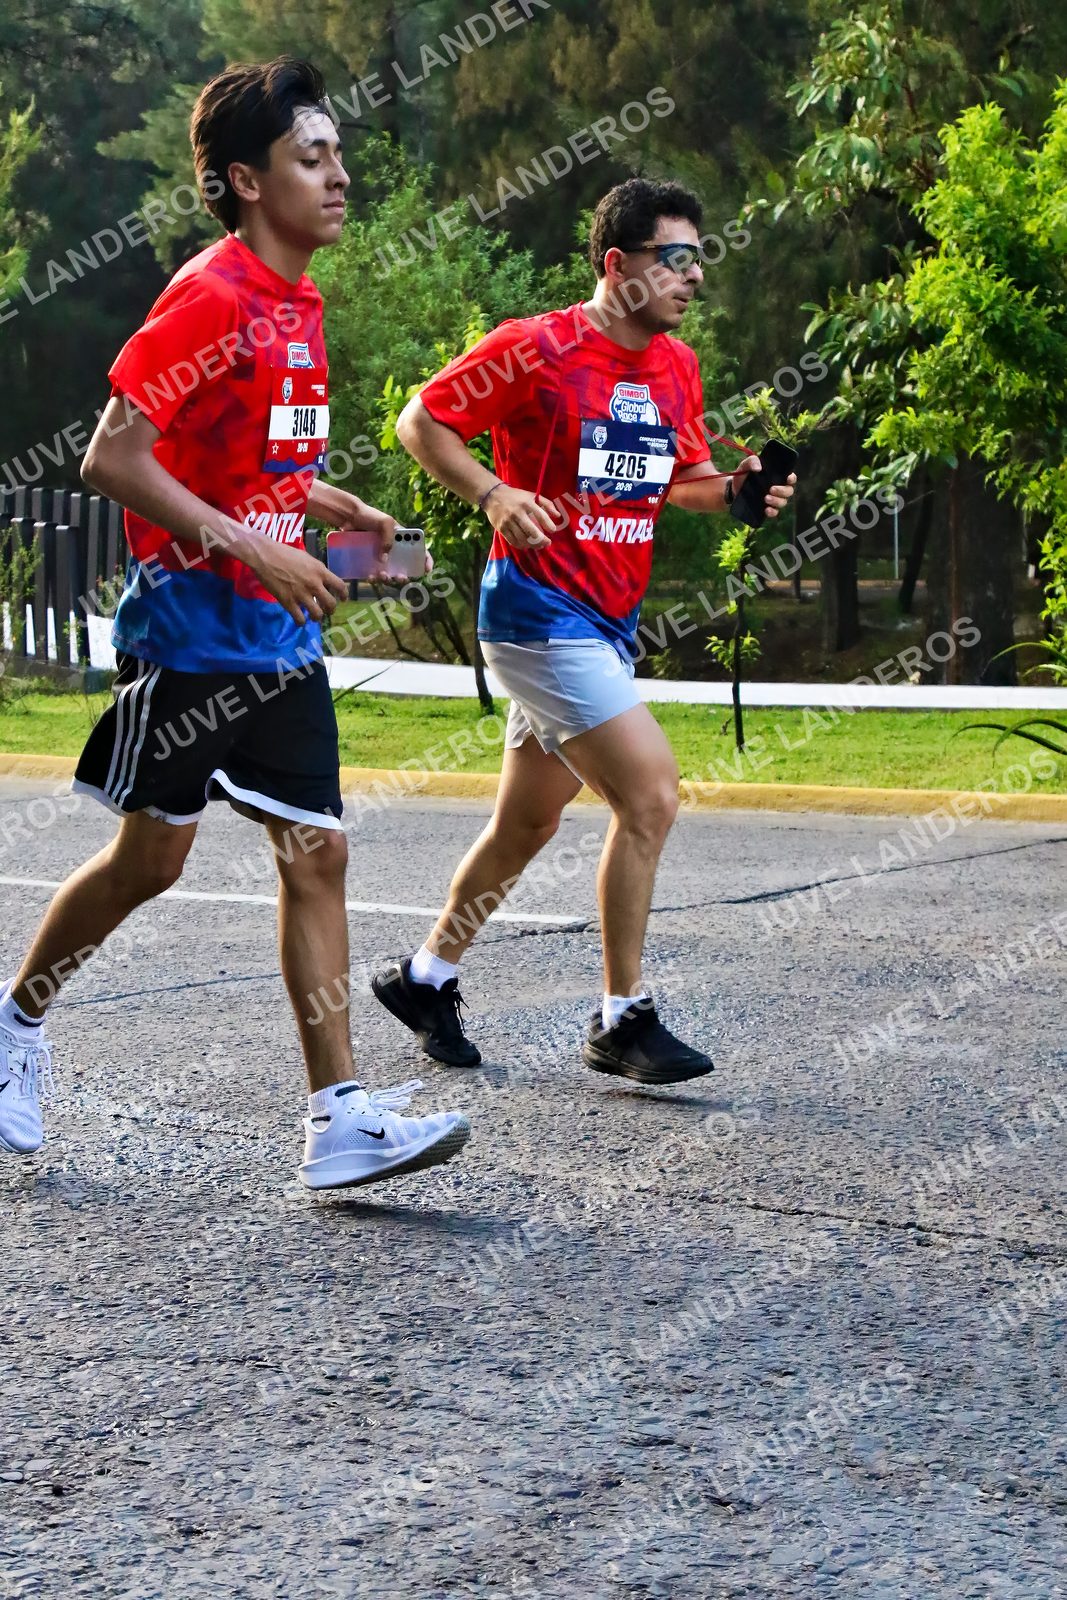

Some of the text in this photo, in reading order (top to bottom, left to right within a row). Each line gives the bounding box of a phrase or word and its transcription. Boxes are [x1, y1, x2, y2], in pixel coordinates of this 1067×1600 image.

[619, 388, 646, 399] BIMBO
[620, 400, 647, 414] Global
[292, 407, 317, 437] 3148
[604, 453, 648, 480] 4205
[615, 482, 633, 492] 20-26
[243, 510, 306, 543] SANTIA
